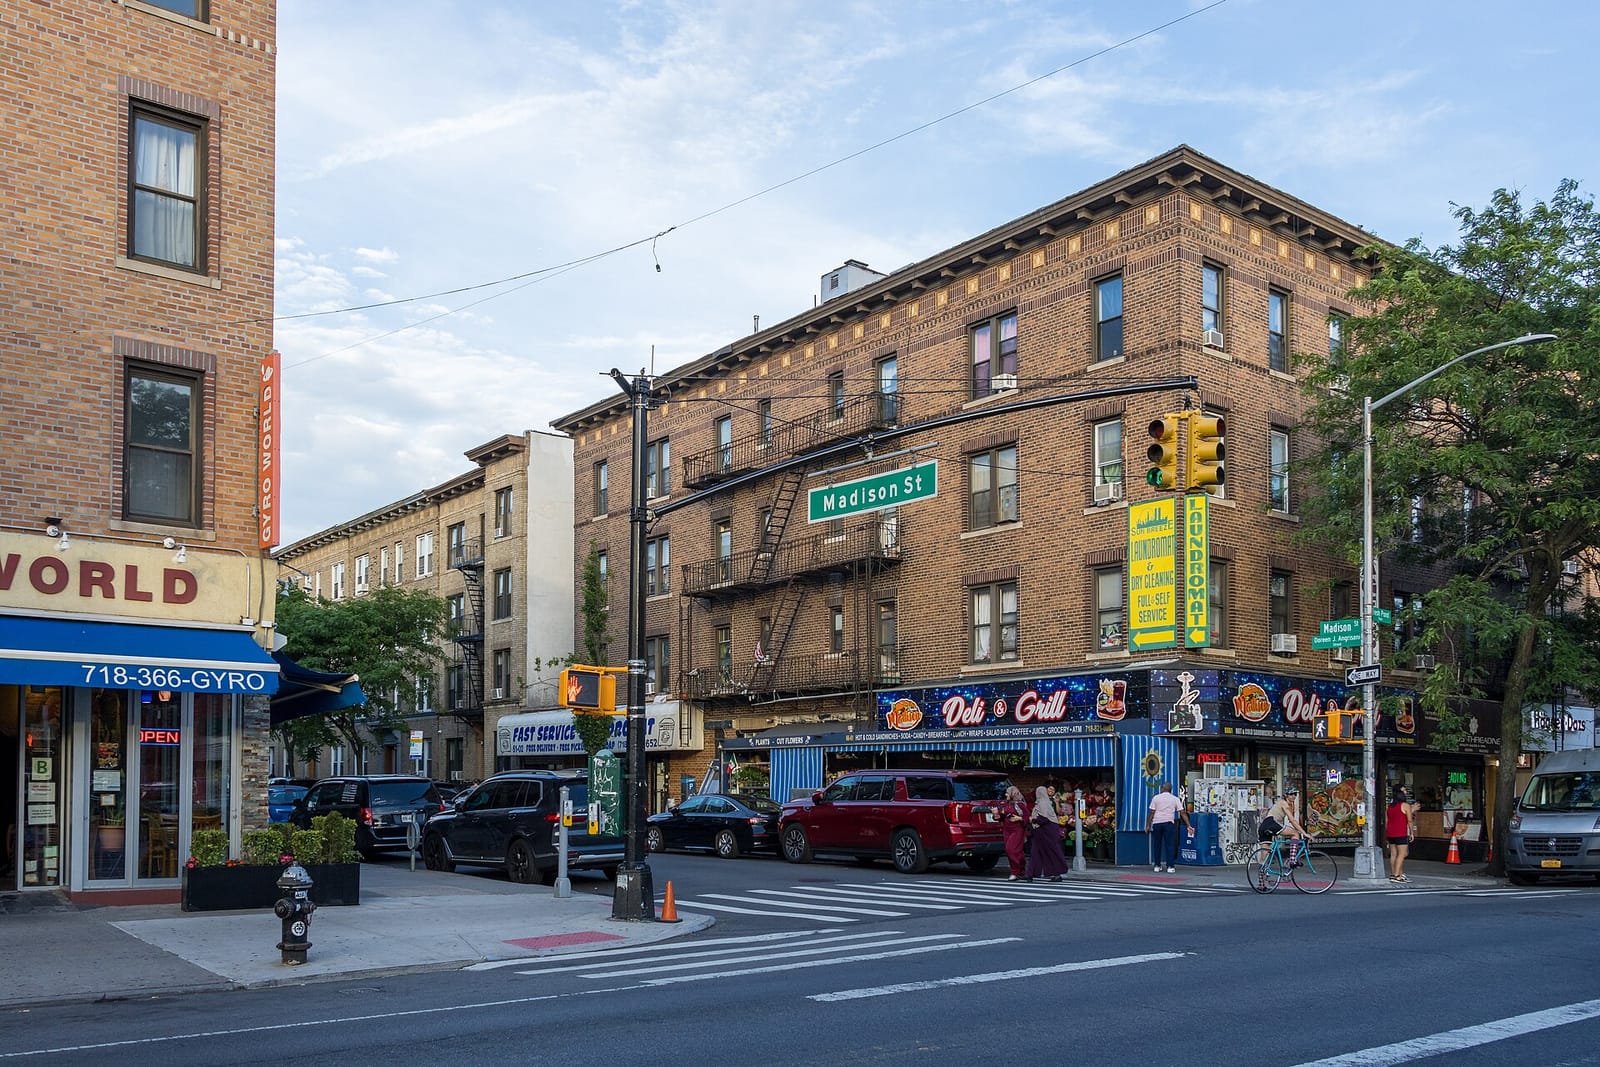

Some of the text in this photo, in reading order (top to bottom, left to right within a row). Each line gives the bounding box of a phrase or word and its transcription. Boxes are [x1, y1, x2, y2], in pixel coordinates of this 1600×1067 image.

[262, 385, 272, 541] GYRO WORLD
[823, 474, 922, 512] Madison St
[1146, 562, 1154, 571] &
[1188, 499, 1205, 625] LAUNDROMAT
[1131, 570, 1174, 591] DRY CLEANING
[1137, 594, 1151, 608] FULL
[1155, 591, 1171, 606] SELF
[1138, 607, 1167, 623] SERVICE
[1323, 622, 1352, 633] Madison
[81, 665, 265, 691] 718-366-GYRO
[1351, 670, 1377, 680] ONE WAY
[943, 696, 986, 726] Deli
[1015, 690, 1067, 723] Grill
[1283, 688, 1320, 722] Deli
[513, 726, 536, 742] FAST
[537, 724, 576, 741] SERVICE
[1048, 726, 1069, 734] GROCERY
[1072, 725, 1082, 733] ATM
[785, 736, 804, 744] FLOWERS
[37, 760, 48, 774] B
[1223, 765, 1245, 777] ICE
